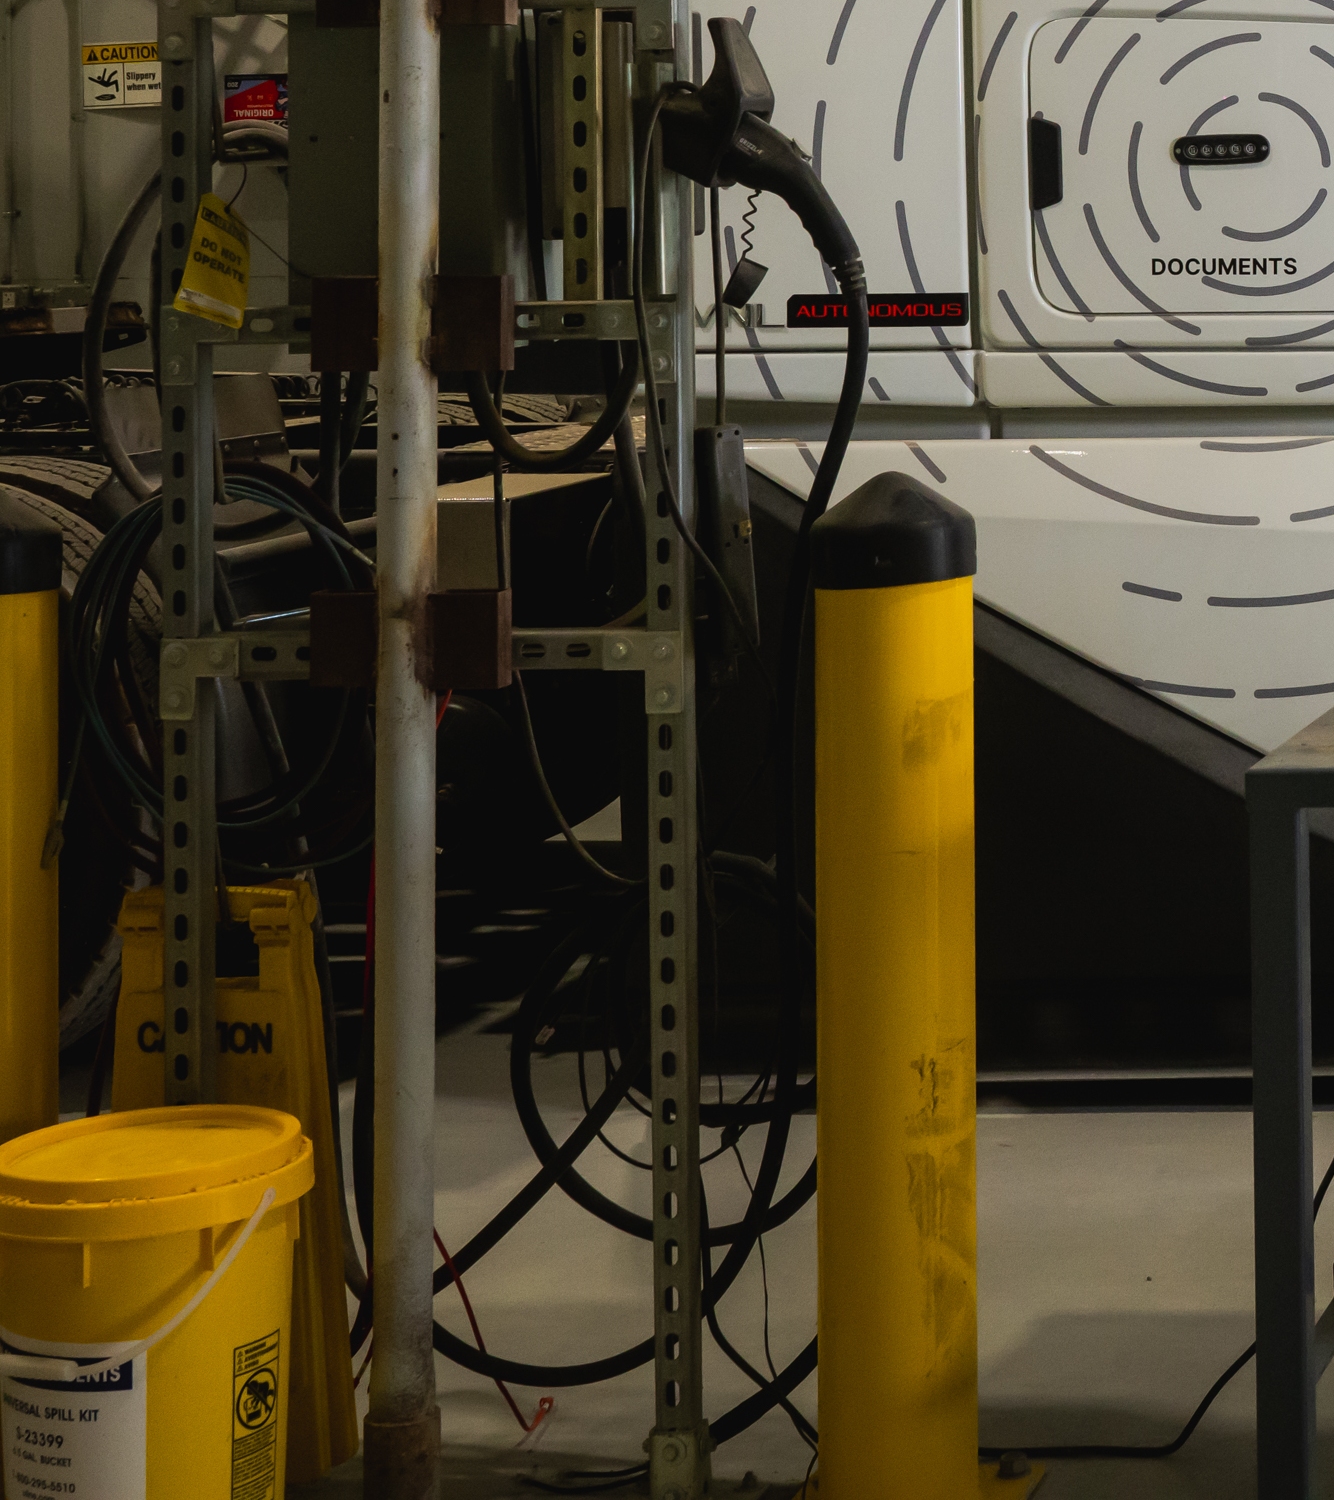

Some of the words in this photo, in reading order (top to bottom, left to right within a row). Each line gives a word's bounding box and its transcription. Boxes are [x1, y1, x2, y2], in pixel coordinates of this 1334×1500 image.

[126, 72, 156, 81] Slippery
[126, 83, 146, 91] when
[148, 82, 161, 90] wet
[233, 108, 275, 117] ORIGINAL
[201, 237, 218, 252] DO
[220, 249, 242, 266] NOT
[193, 251, 245, 284] OPERATE
[1150, 257, 1298, 276] DOCUMENTS
[796, 302, 963, 318] AUTNOMOUS
[137, 1020, 273, 1054] CION
[44, 1407, 74, 1422] SPILL
[79, 1409, 100, 1422] KIT
[16, 1426, 64, 1448] S-23399
[40, 1455, 72, 1468] BUCKET
